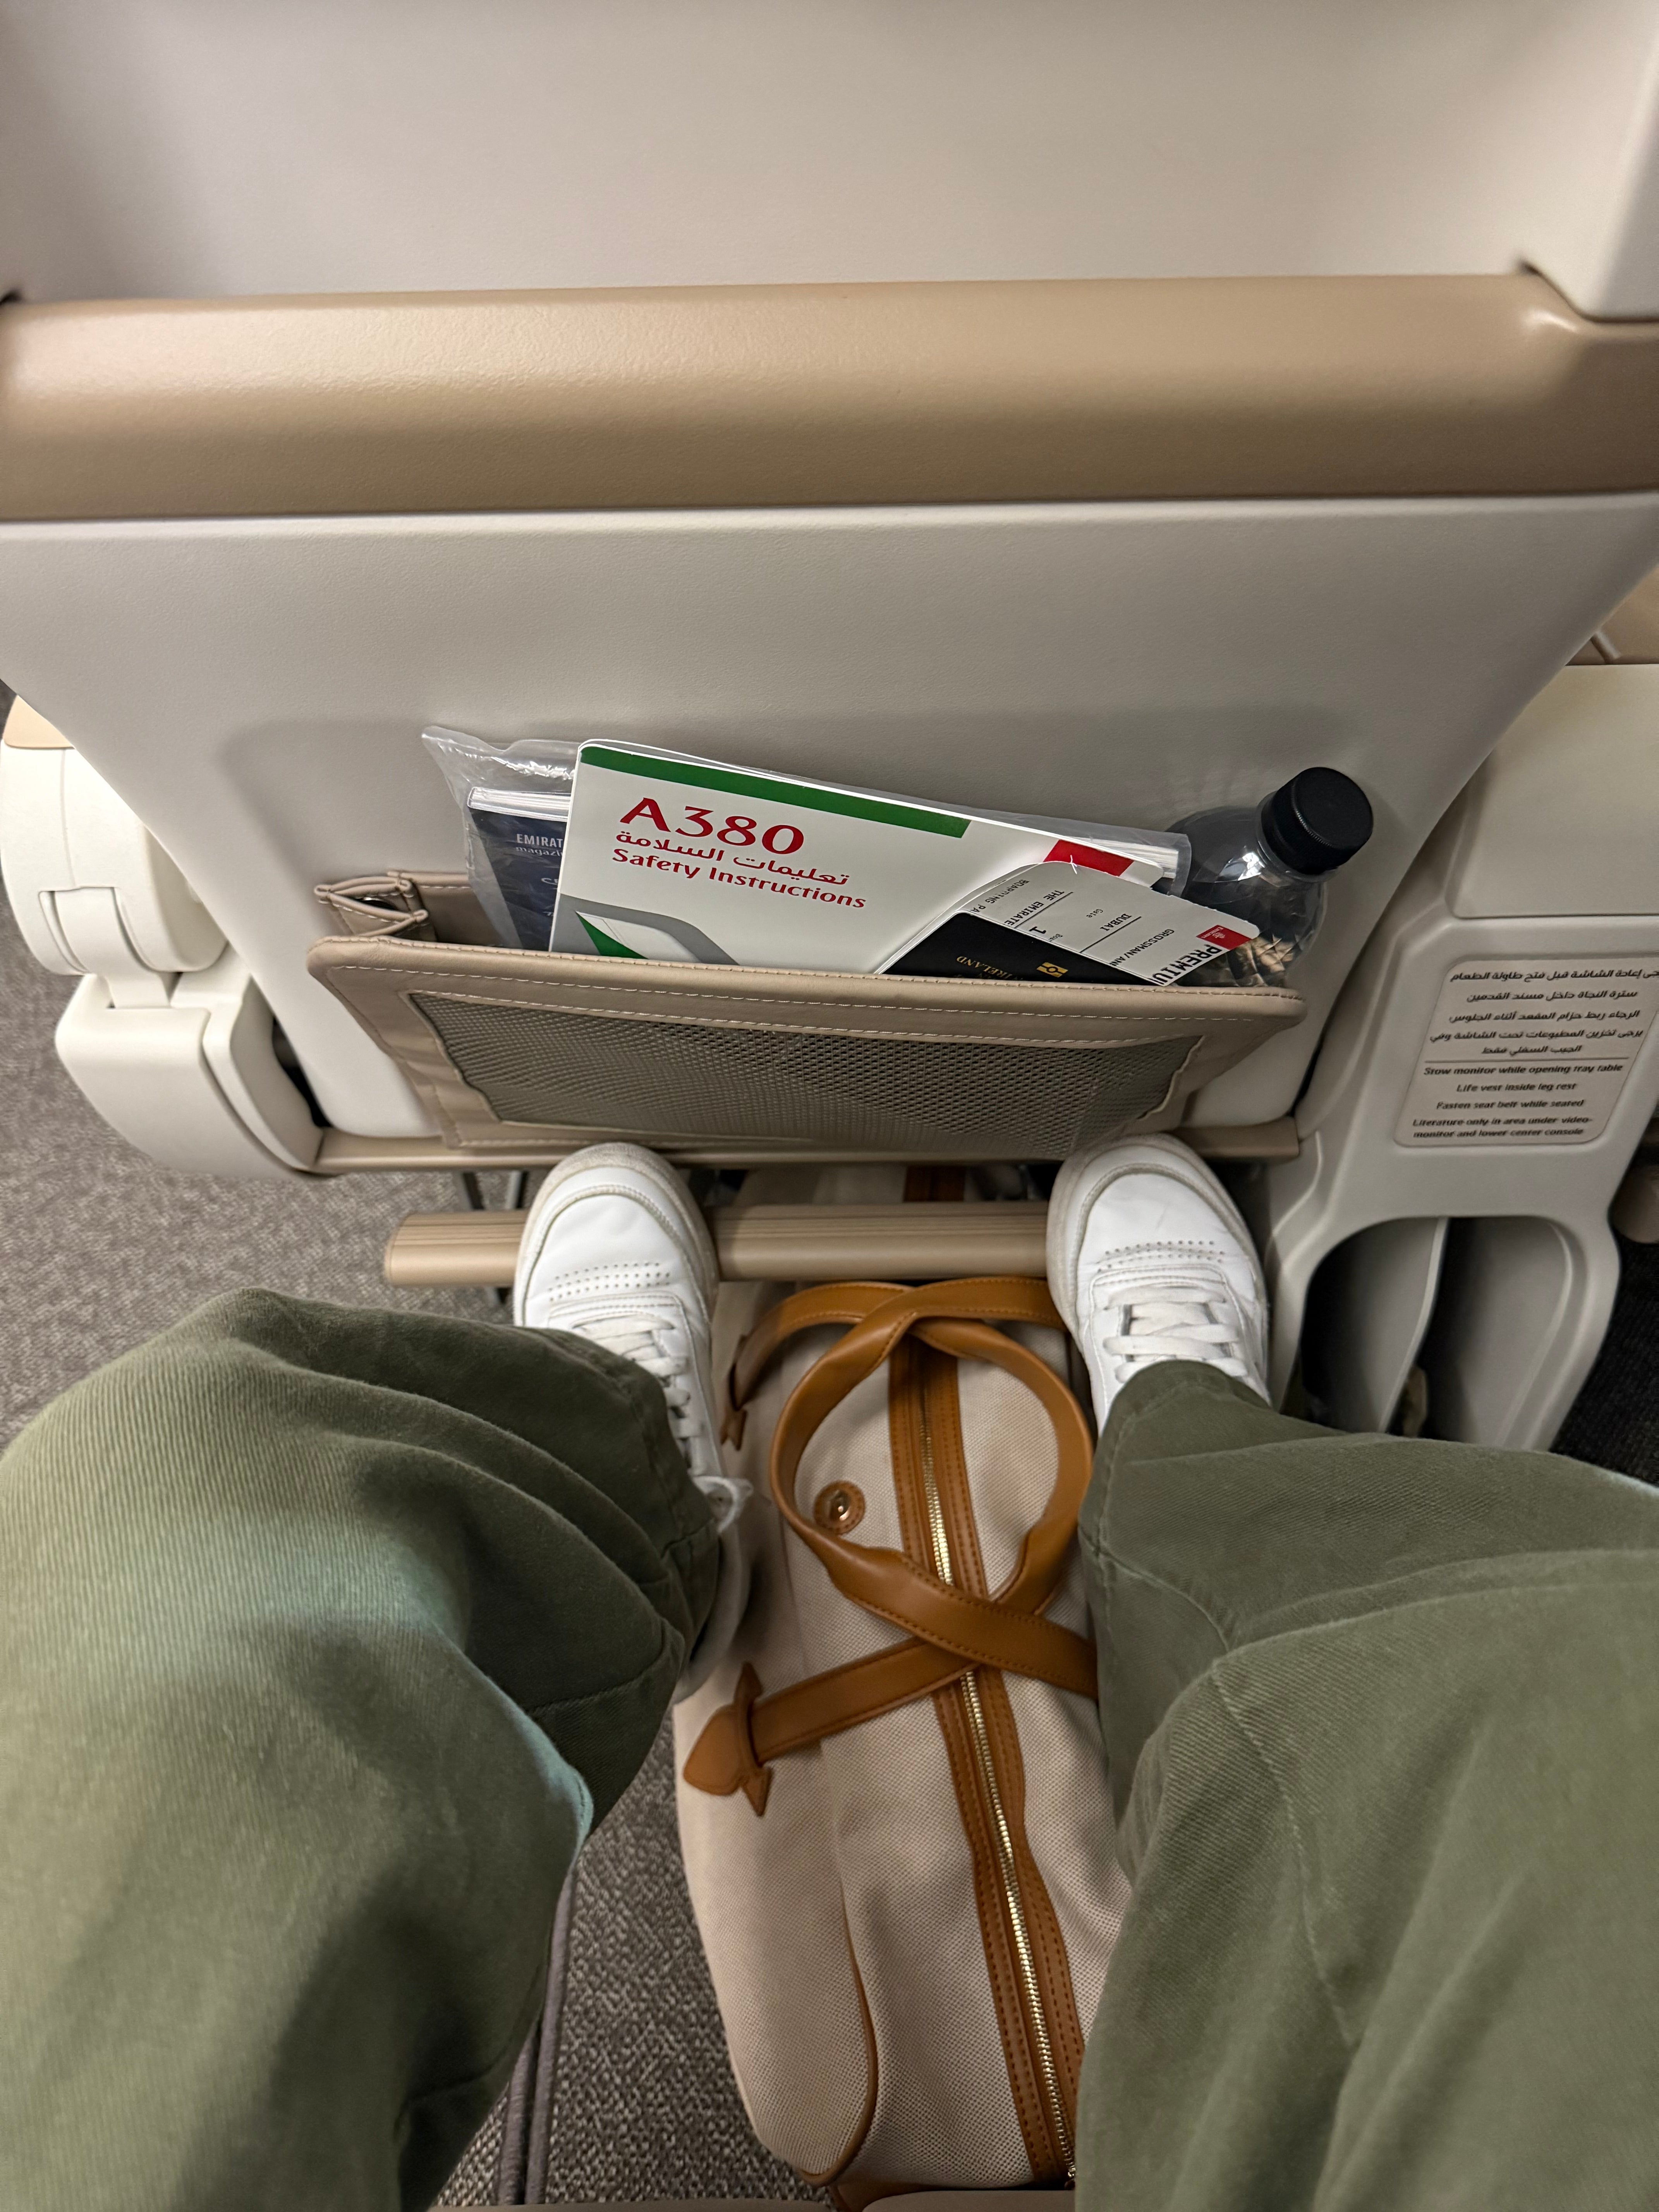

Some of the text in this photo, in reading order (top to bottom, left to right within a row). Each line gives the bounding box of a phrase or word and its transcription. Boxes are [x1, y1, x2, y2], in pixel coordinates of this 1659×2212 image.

[620, 797, 804, 854] A380
[517, 833, 563, 848] EMIRAT
[616, 831, 850, 885] تعليمات السلامة
[612, 849, 866, 908] Safety Instructions
[970, 904, 986, 912] PA
[1004, 890, 1065, 926] THE EMIRATE
[1100, 913, 1132, 931] DUBAI
[956, 956, 1012, 979] IRELAND
[1528, 1065, 1571, 1074] opening
[1456, 1084, 1478, 1092] Life
[1538, 1084, 1554, 1092] leg
